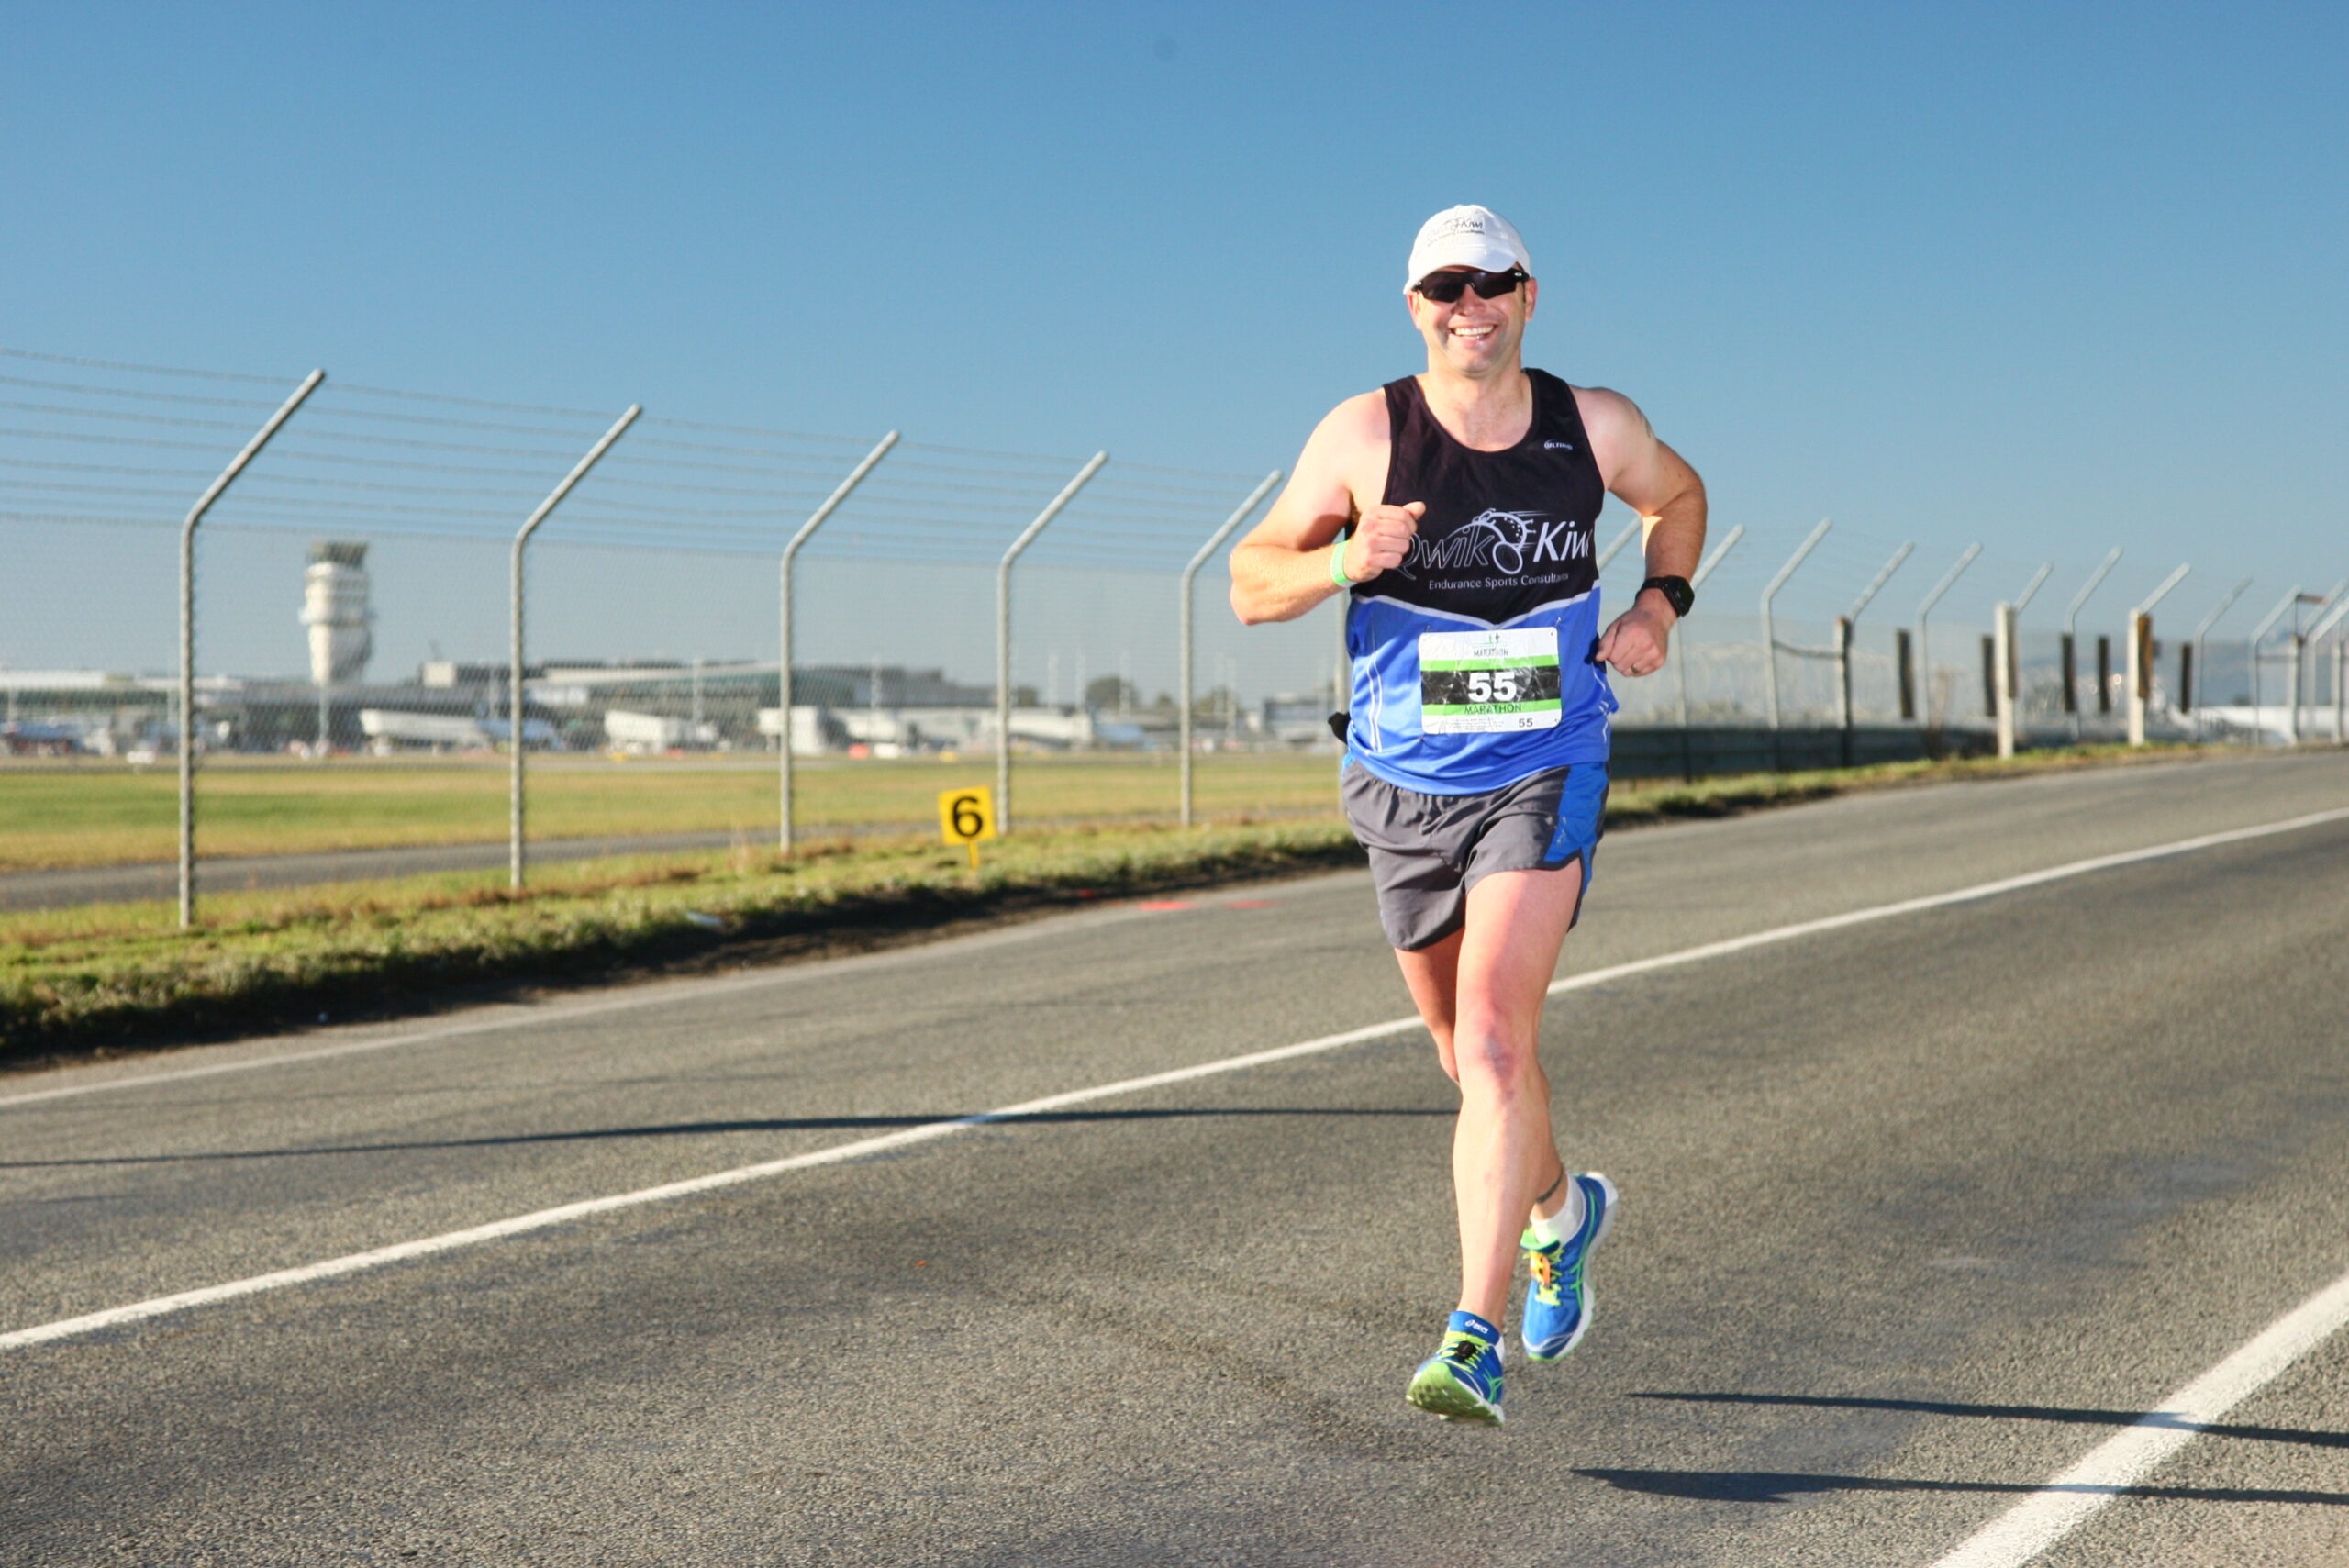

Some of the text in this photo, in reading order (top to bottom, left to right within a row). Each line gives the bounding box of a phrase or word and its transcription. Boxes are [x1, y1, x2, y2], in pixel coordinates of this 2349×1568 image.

[1429, 578, 1482, 590] Endurance
[1485, 577, 1518, 590] Sports
[1468, 672, 1517, 703] 55
[1464, 704, 1521, 715] MARATHON
[1519, 717, 1533, 728] 55
[952, 795, 983, 838] 6
